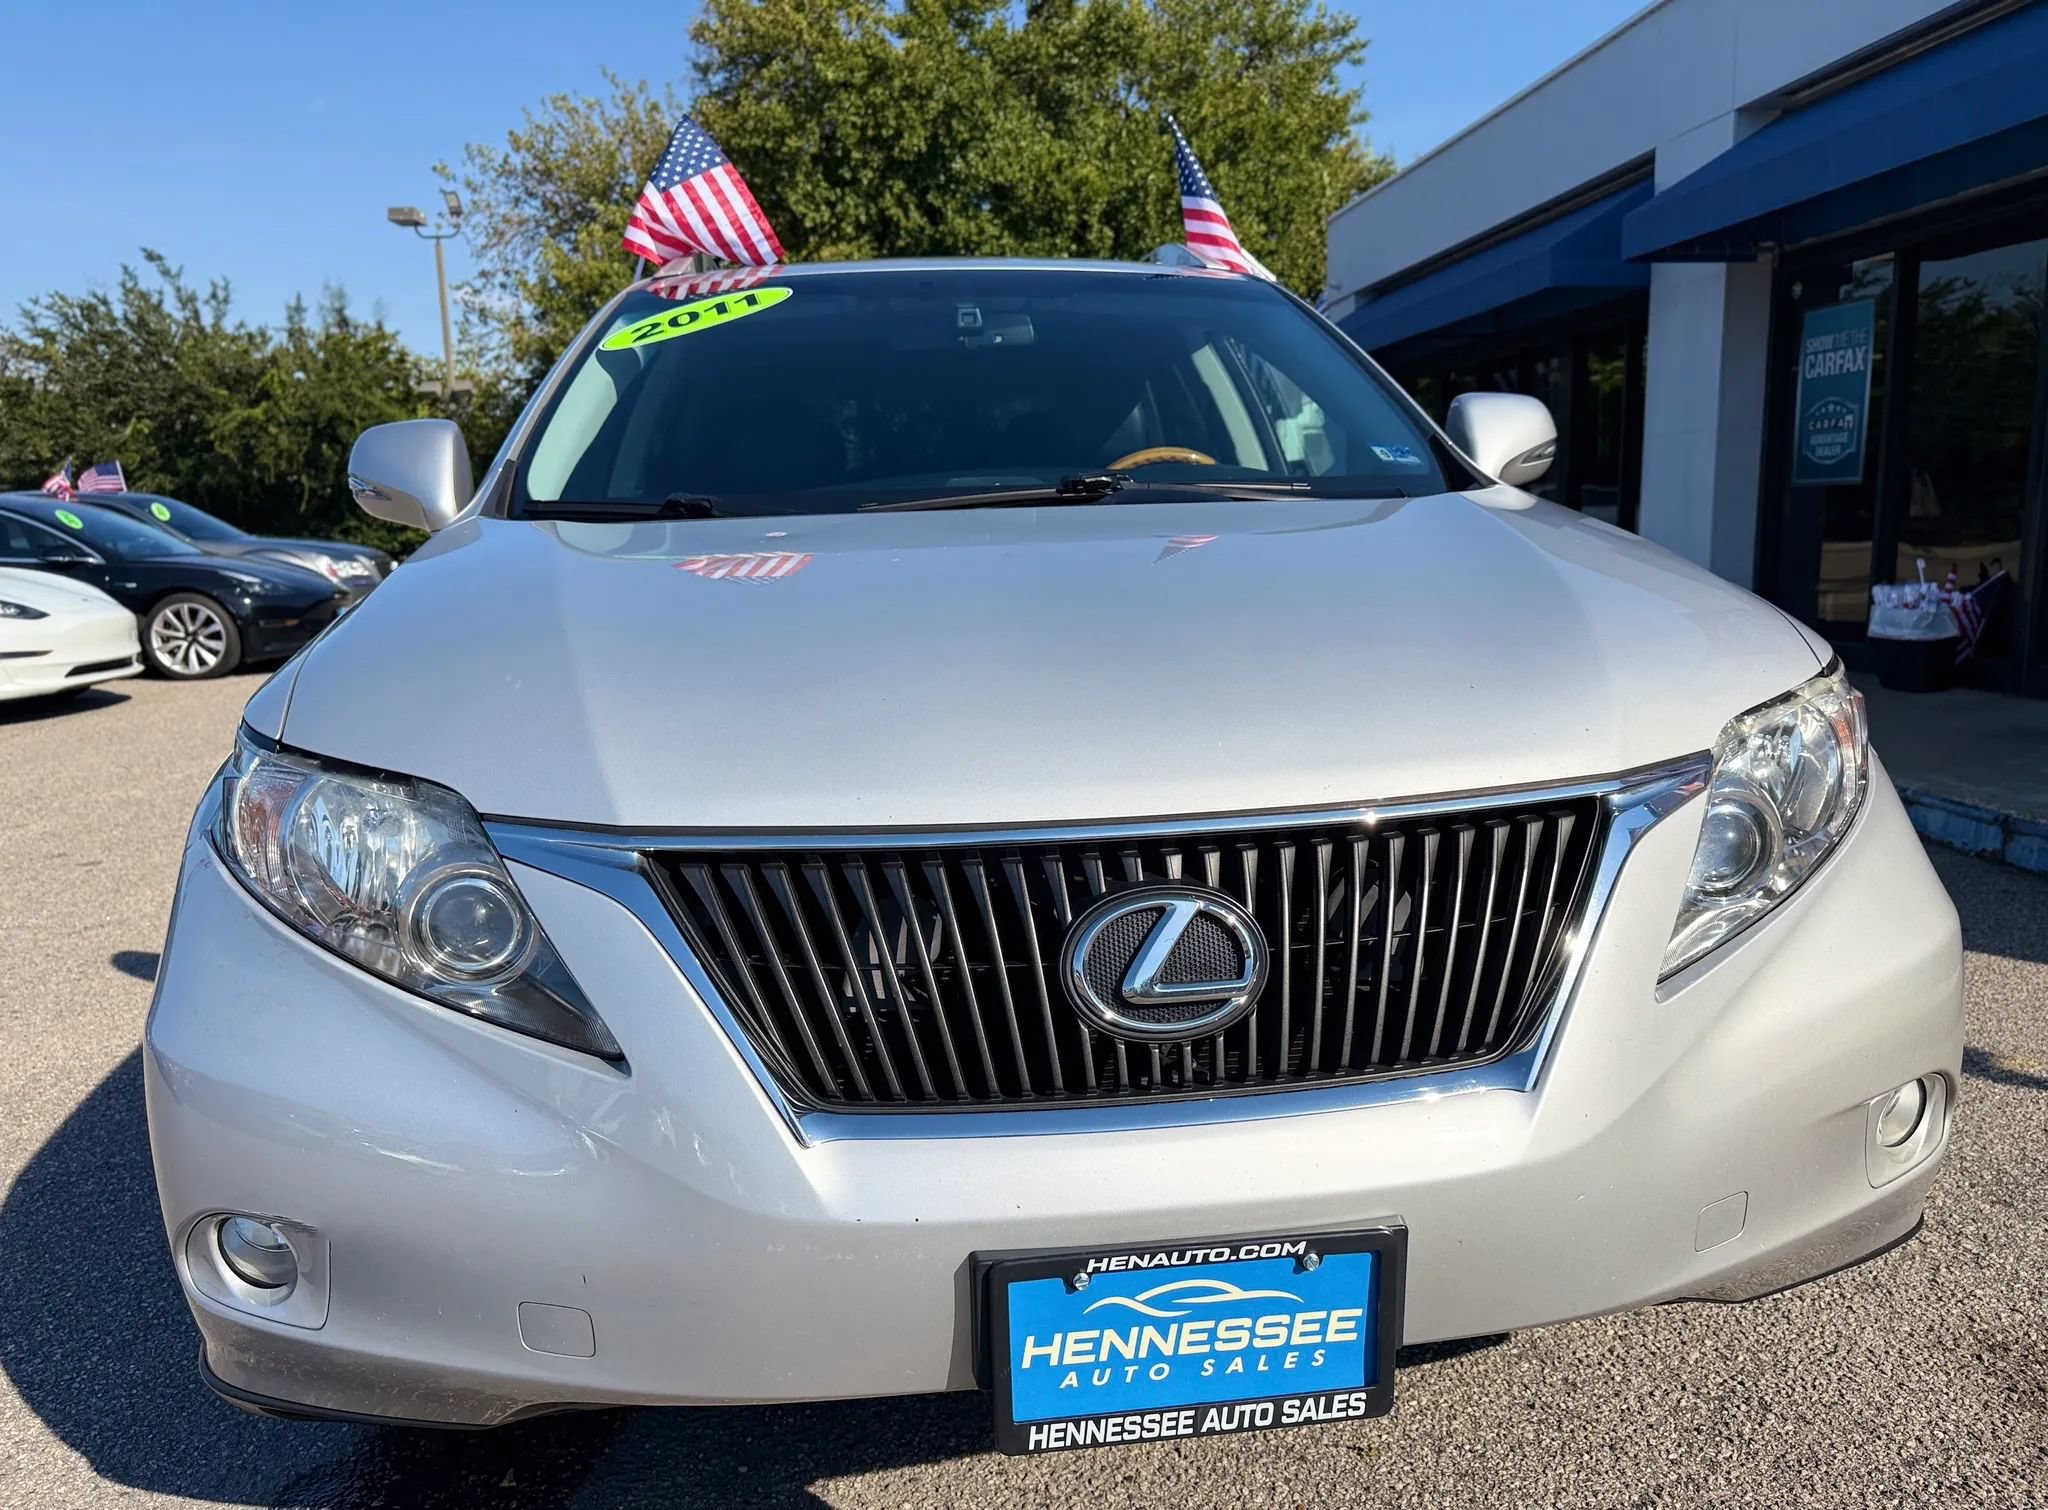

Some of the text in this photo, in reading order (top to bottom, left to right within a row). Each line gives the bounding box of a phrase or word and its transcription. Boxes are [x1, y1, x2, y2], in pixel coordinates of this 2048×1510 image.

[631, 293, 760, 343] 2011
[1806, 333, 1834, 353] SHOW
[1850, 328, 1868, 345] THE
[1805, 345, 1868, 379] CARFAX
[1086, 1241, 1307, 1273] HENAUTO.COM
[1021, 1308, 1362, 1369] HENNESSEE
[1059, 1349, 1326, 1389] AUTO SALES
[1028, 1392, 1367, 1450] HENNESSEE AUTO SALES
